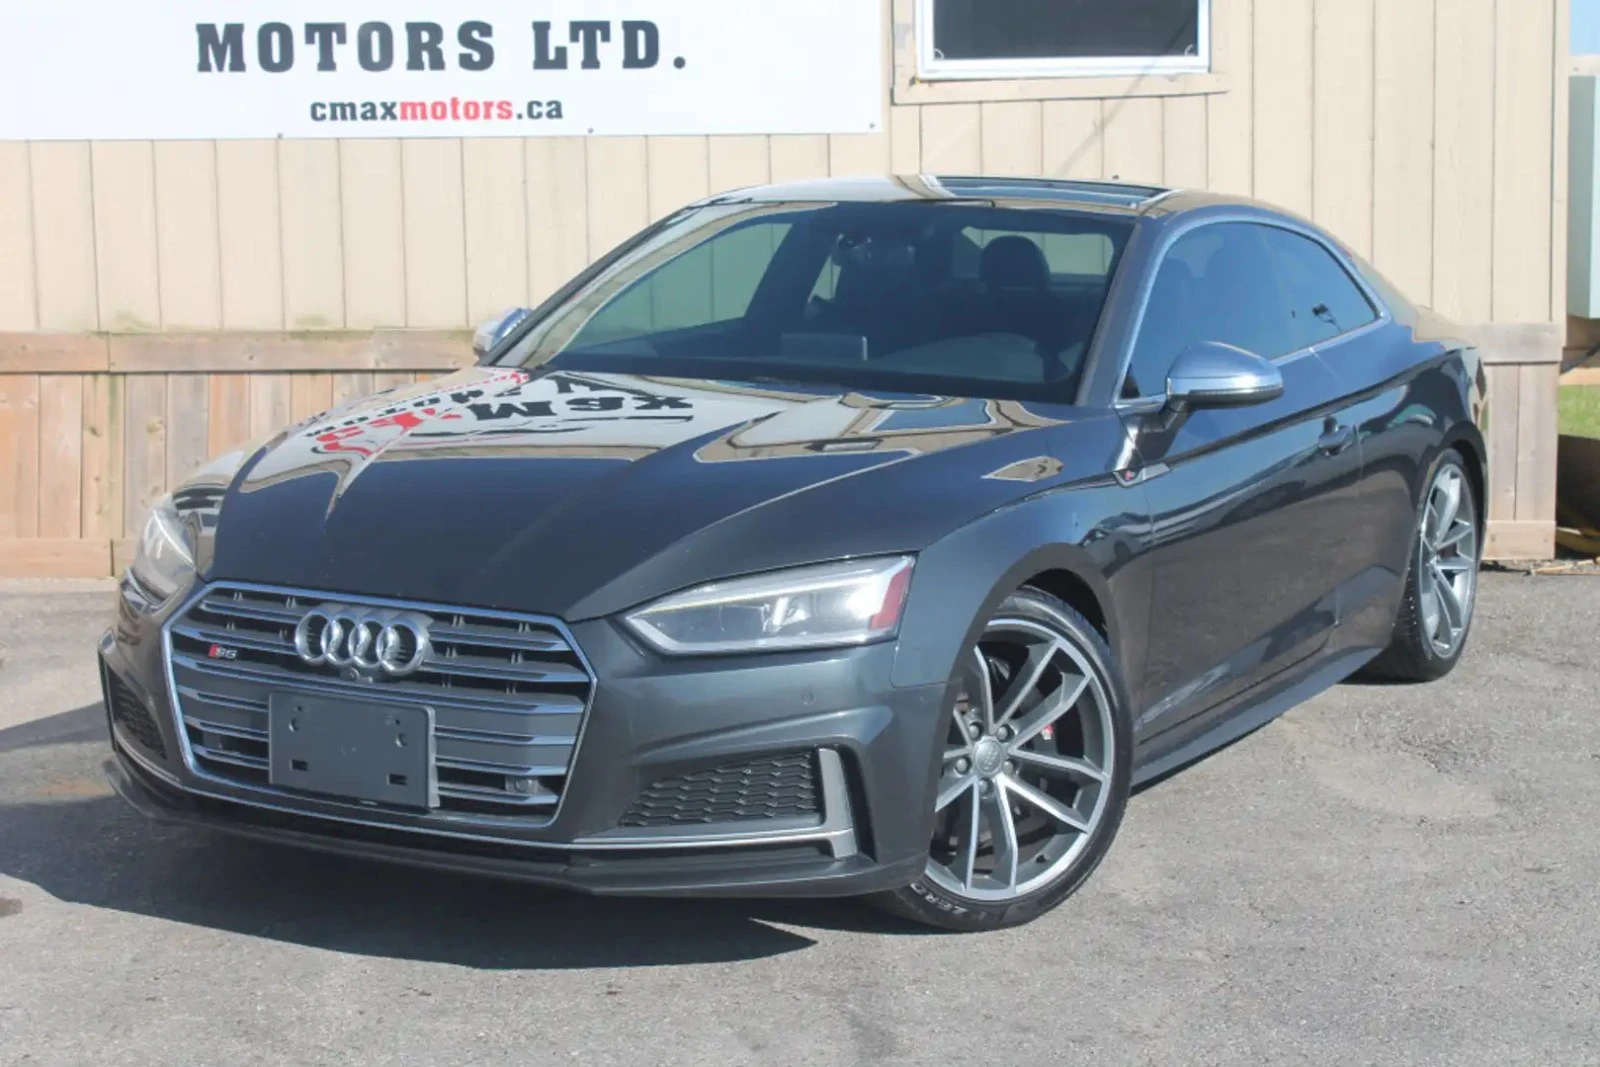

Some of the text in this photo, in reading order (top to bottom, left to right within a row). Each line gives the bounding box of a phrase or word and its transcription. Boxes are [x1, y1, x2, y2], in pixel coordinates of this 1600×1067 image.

[195, 20, 687, 73] MOTORS LTD.
[310, 97, 563, 122] cmaxmotors.ca
